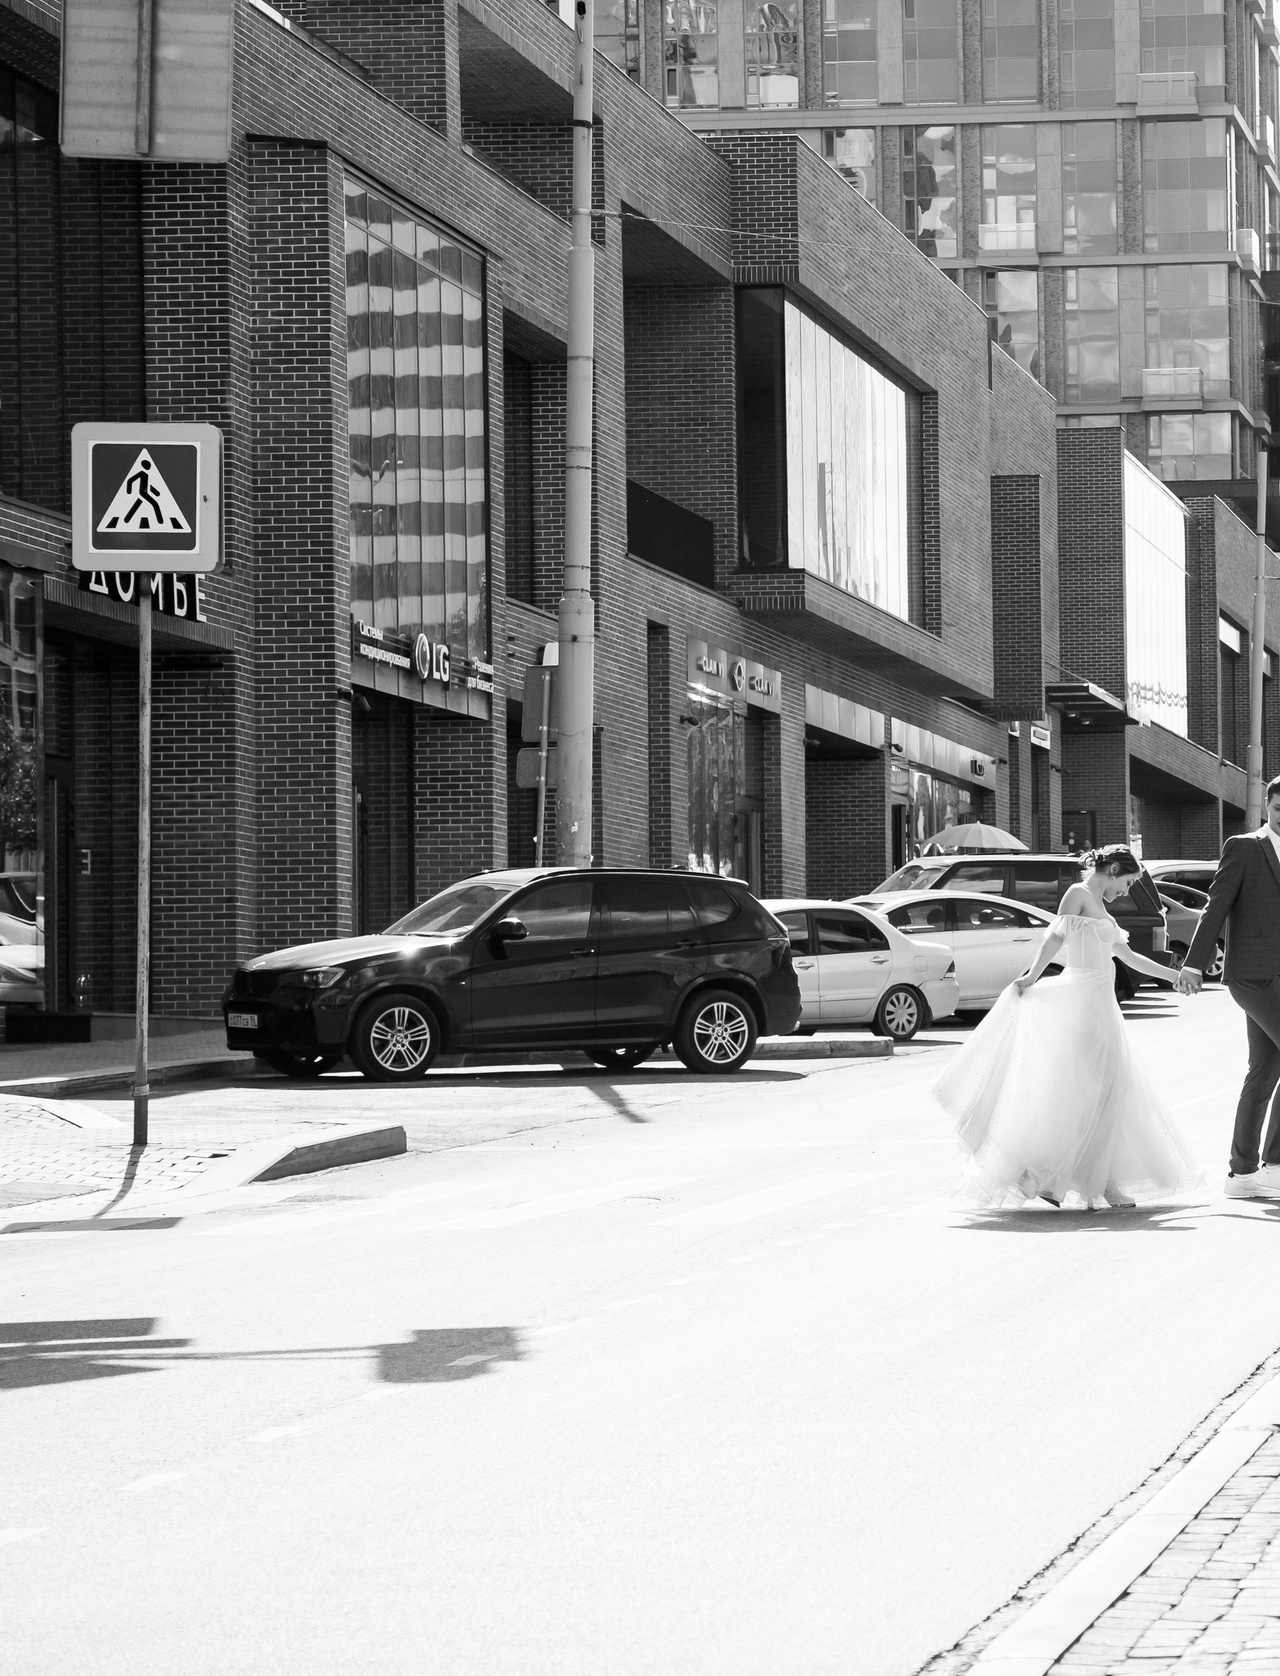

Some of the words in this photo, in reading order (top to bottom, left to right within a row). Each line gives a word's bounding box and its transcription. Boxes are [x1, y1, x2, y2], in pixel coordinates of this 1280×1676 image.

[360, 619, 384, 641] Системы
[360, 642, 411, 669] кондиционирования
[432, 642, 451, 682] LG
